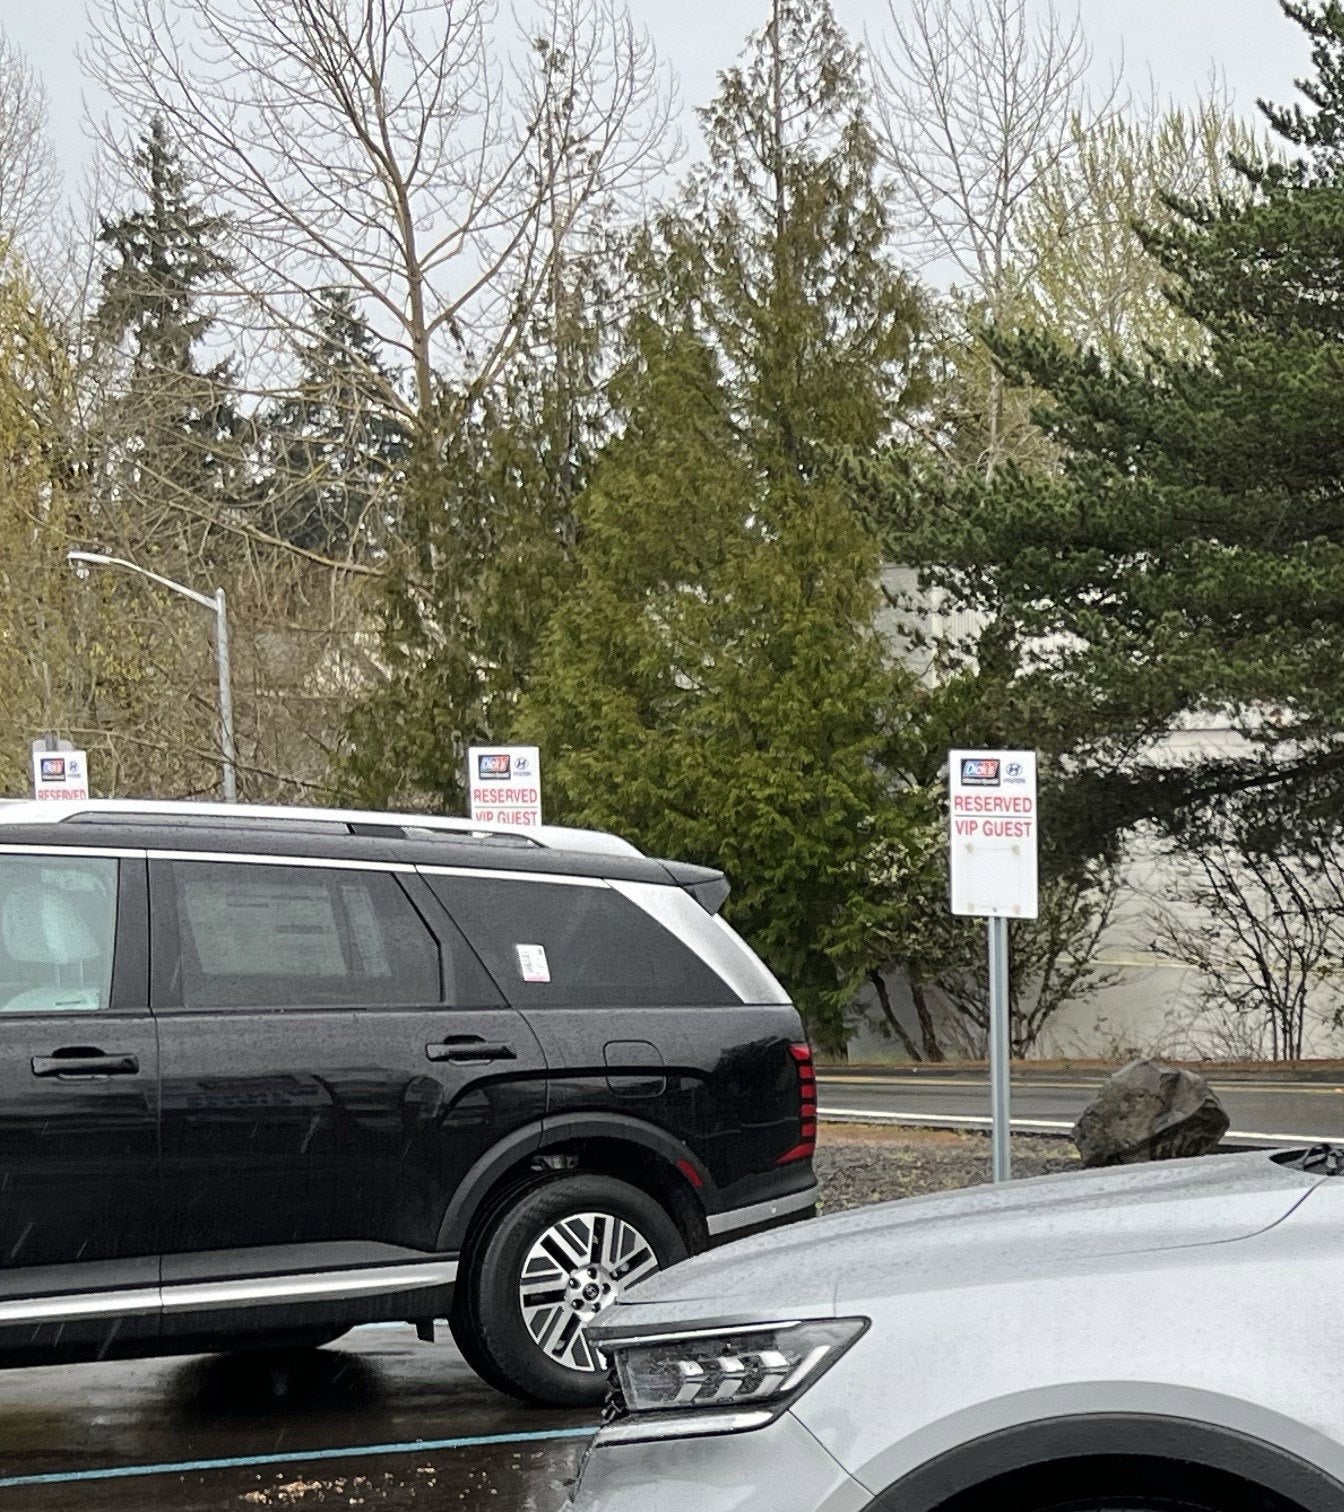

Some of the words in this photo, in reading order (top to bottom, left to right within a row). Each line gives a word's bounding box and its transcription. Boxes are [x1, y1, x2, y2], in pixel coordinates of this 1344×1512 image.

[473, 788, 538, 804] RESERVED
[954, 796, 1033, 813] RESERVED
[475, 811, 494, 822] VIP
[497, 811, 538, 826] GUEST
[955, 820, 978, 836] VIP
[982, 820, 1033, 838] GUEST
